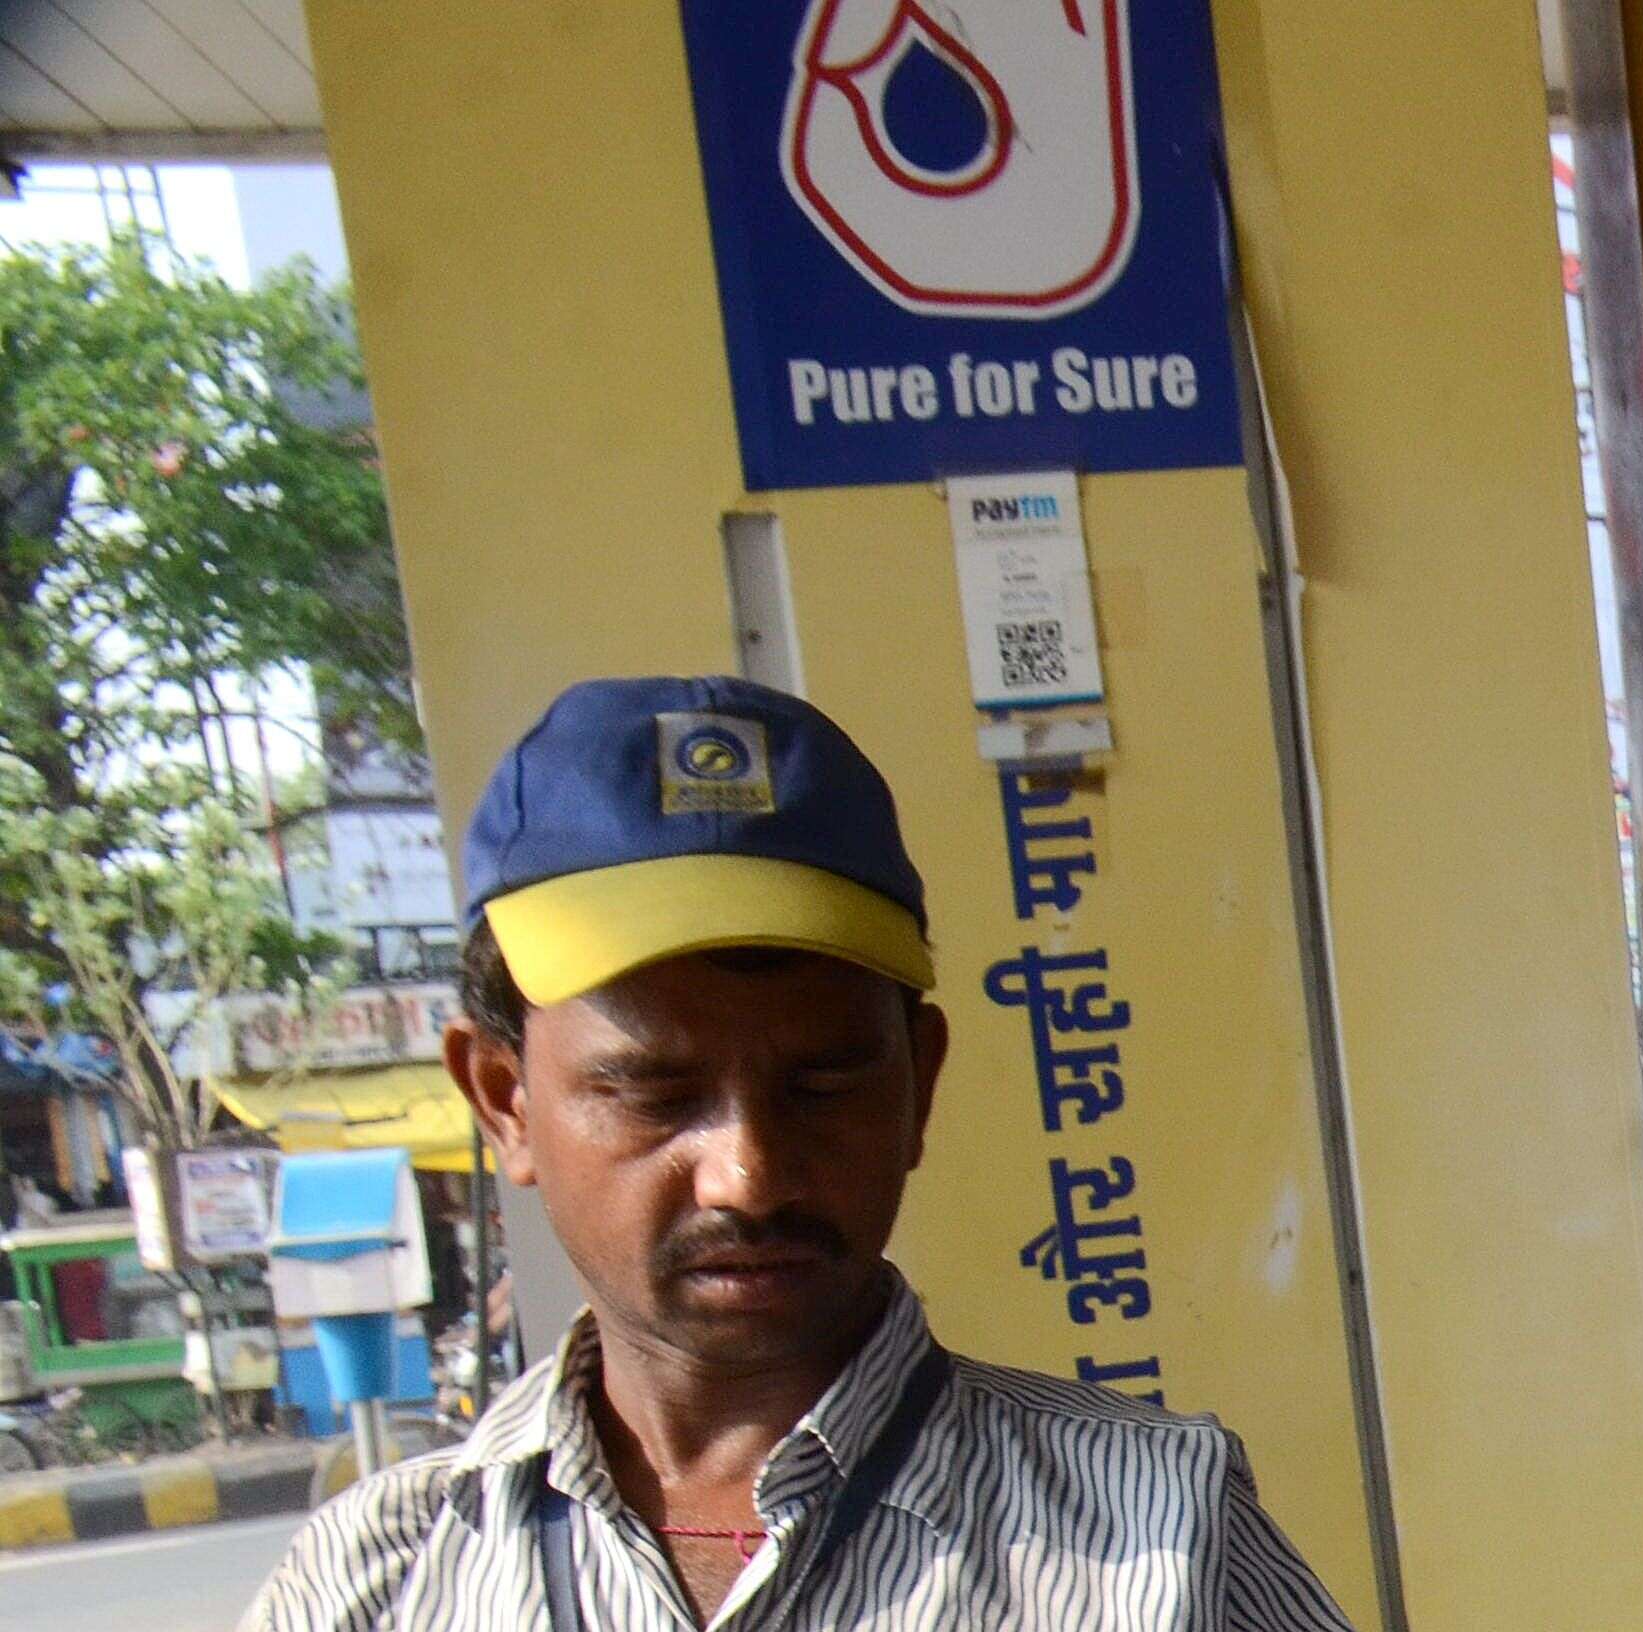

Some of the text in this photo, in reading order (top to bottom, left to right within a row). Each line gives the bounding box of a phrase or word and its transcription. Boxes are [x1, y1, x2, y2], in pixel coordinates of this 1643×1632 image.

[788, 345, 1199, 426] Pure for Sure
[984, 945, 1131, 1132] सही
[1020, 1155, 1152, 1326] और
